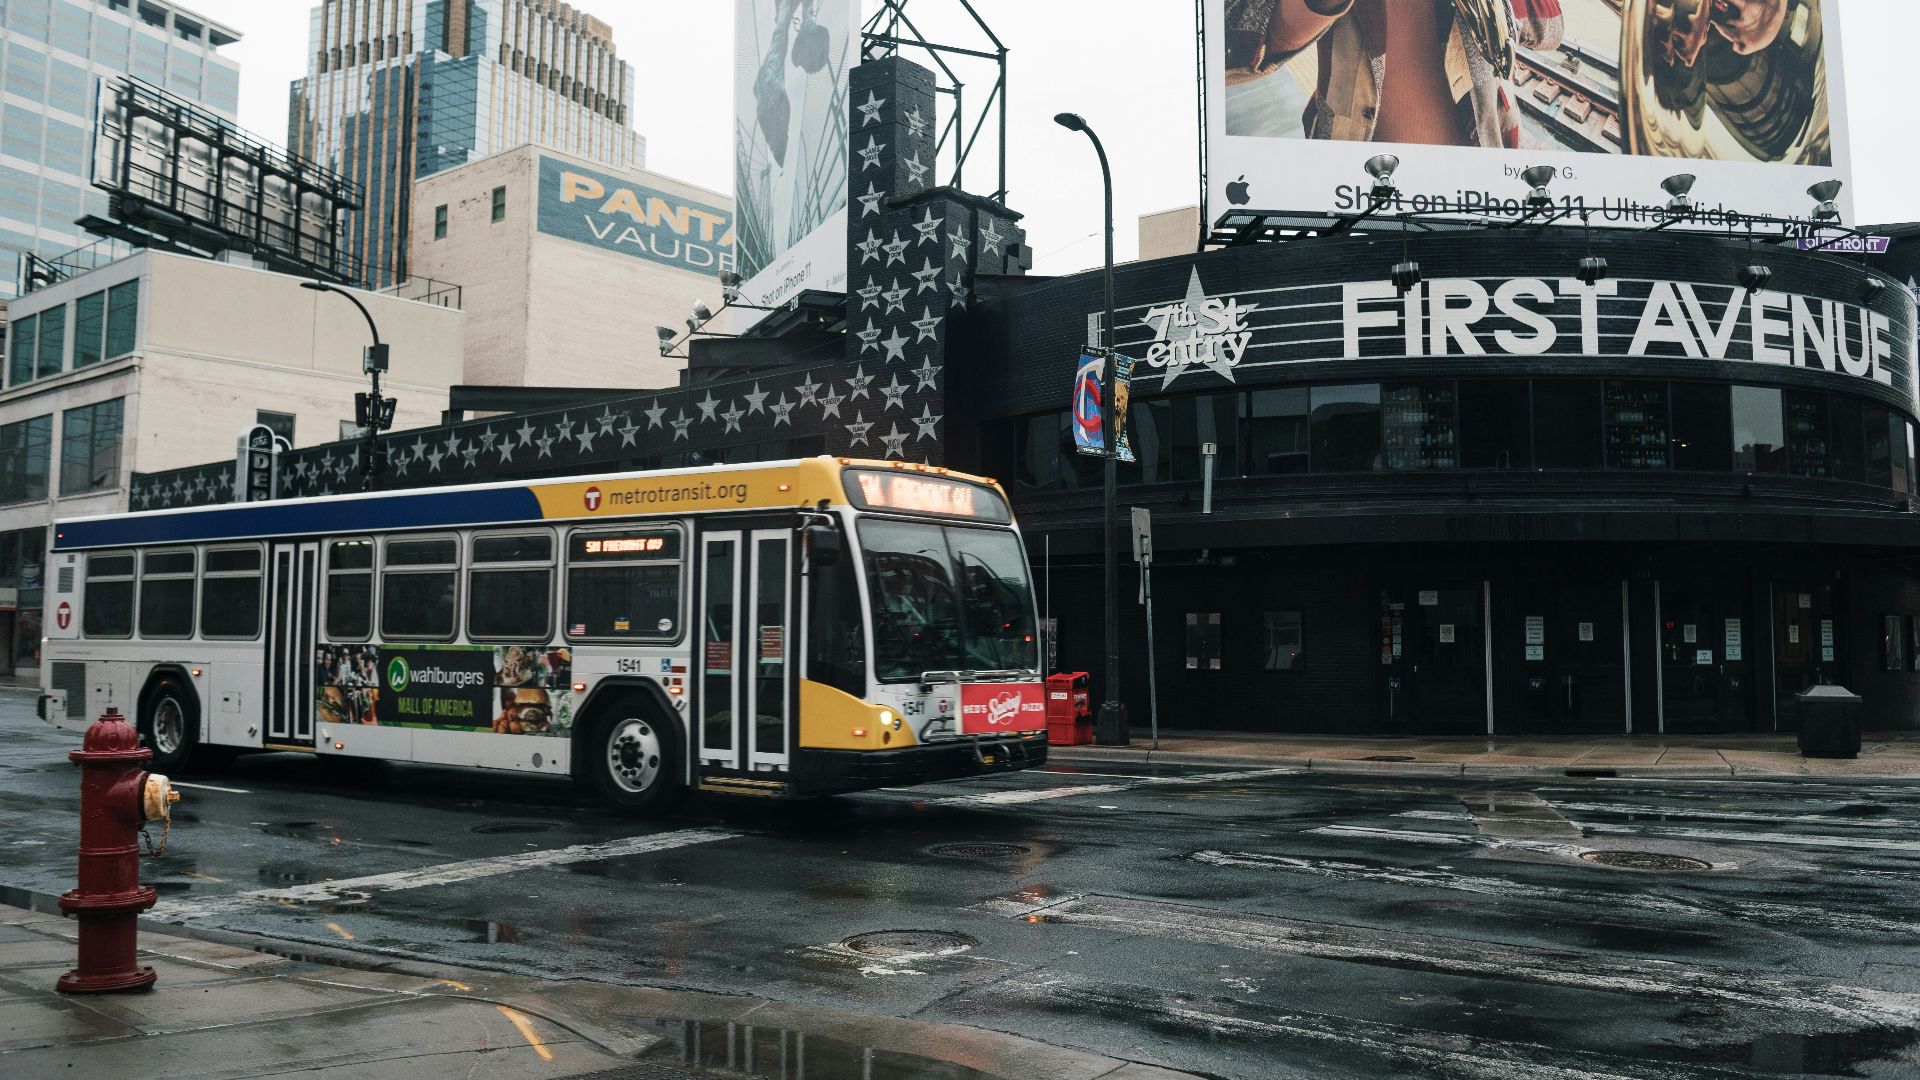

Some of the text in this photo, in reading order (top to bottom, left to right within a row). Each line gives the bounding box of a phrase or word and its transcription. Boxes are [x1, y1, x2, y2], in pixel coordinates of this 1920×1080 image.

[1504, 164, 1521, 180] by
[1412, 194, 1447, 213] on
[1560, 195, 1584, 219] 11
[1603, 197, 1665, 223] Ultra
[1785, 222, 1811, 238] 217
[761, 289, 775, 307] Shot
[783, 270, 805, 295] iPhone
[1143, 297, 1249, 341] 7th St
[1342, 278, 1892, 387] FIRST AVENUE
[1147, 328, 1253, 368] entry
[610, 481, 748, 505] metrotransit.org
[617, 659, 641, 672] 1541
[410, 666, 484, 689] wahlburgers
[398, 697, 474, 718] MALL OF AMERICA
[903, 700, 926, 716] 1541
